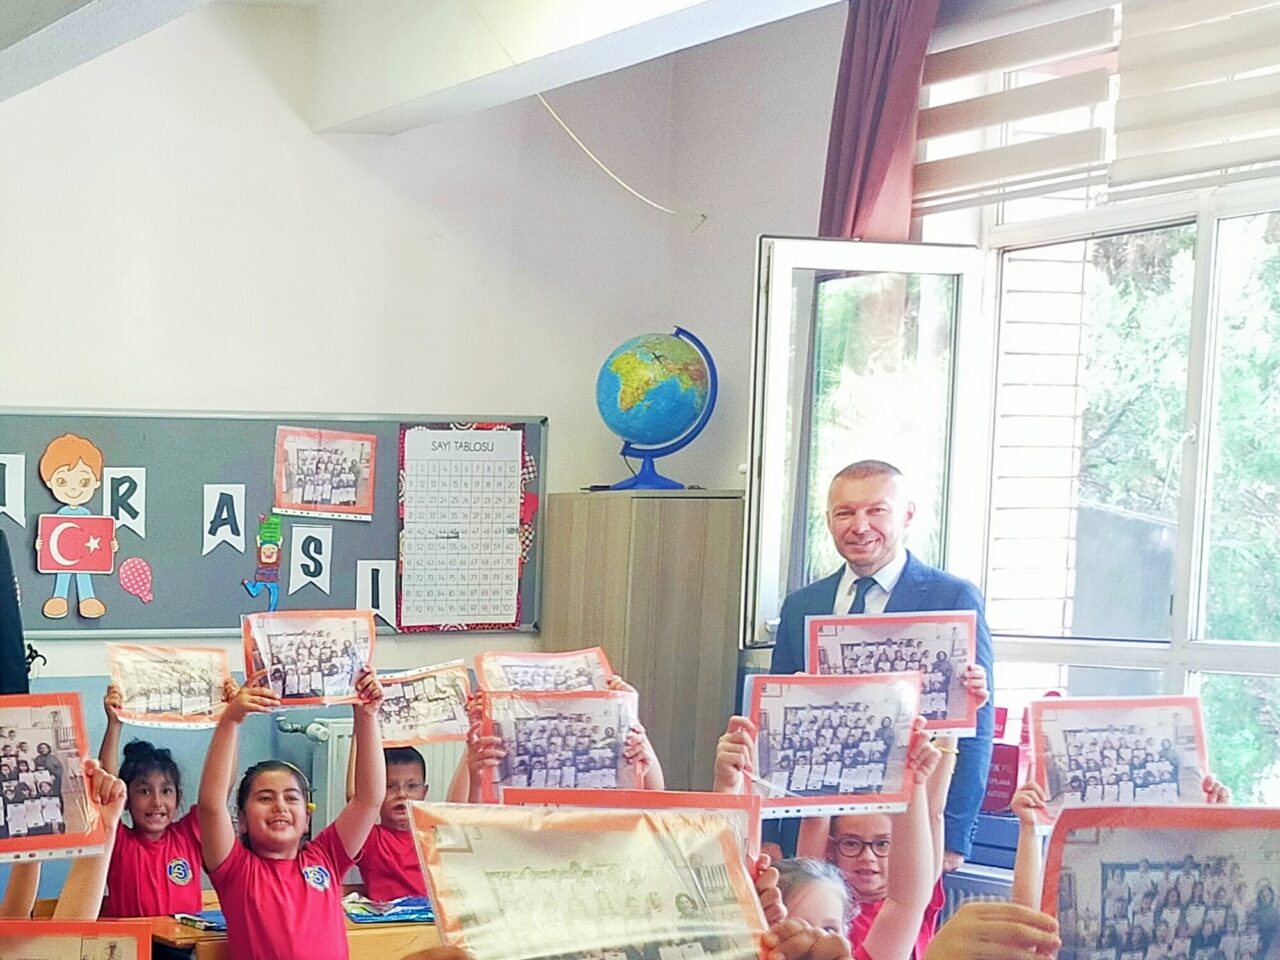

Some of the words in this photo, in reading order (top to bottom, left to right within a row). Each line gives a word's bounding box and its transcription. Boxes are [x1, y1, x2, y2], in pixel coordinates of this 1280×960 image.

[431, 441, 451, 452] SAYI
[454, 441, 494, 452] TABLOSU
[111, 476, 139, 520] R
[208, 493, 240, 536] A
[301, 536, 322, 577] S
